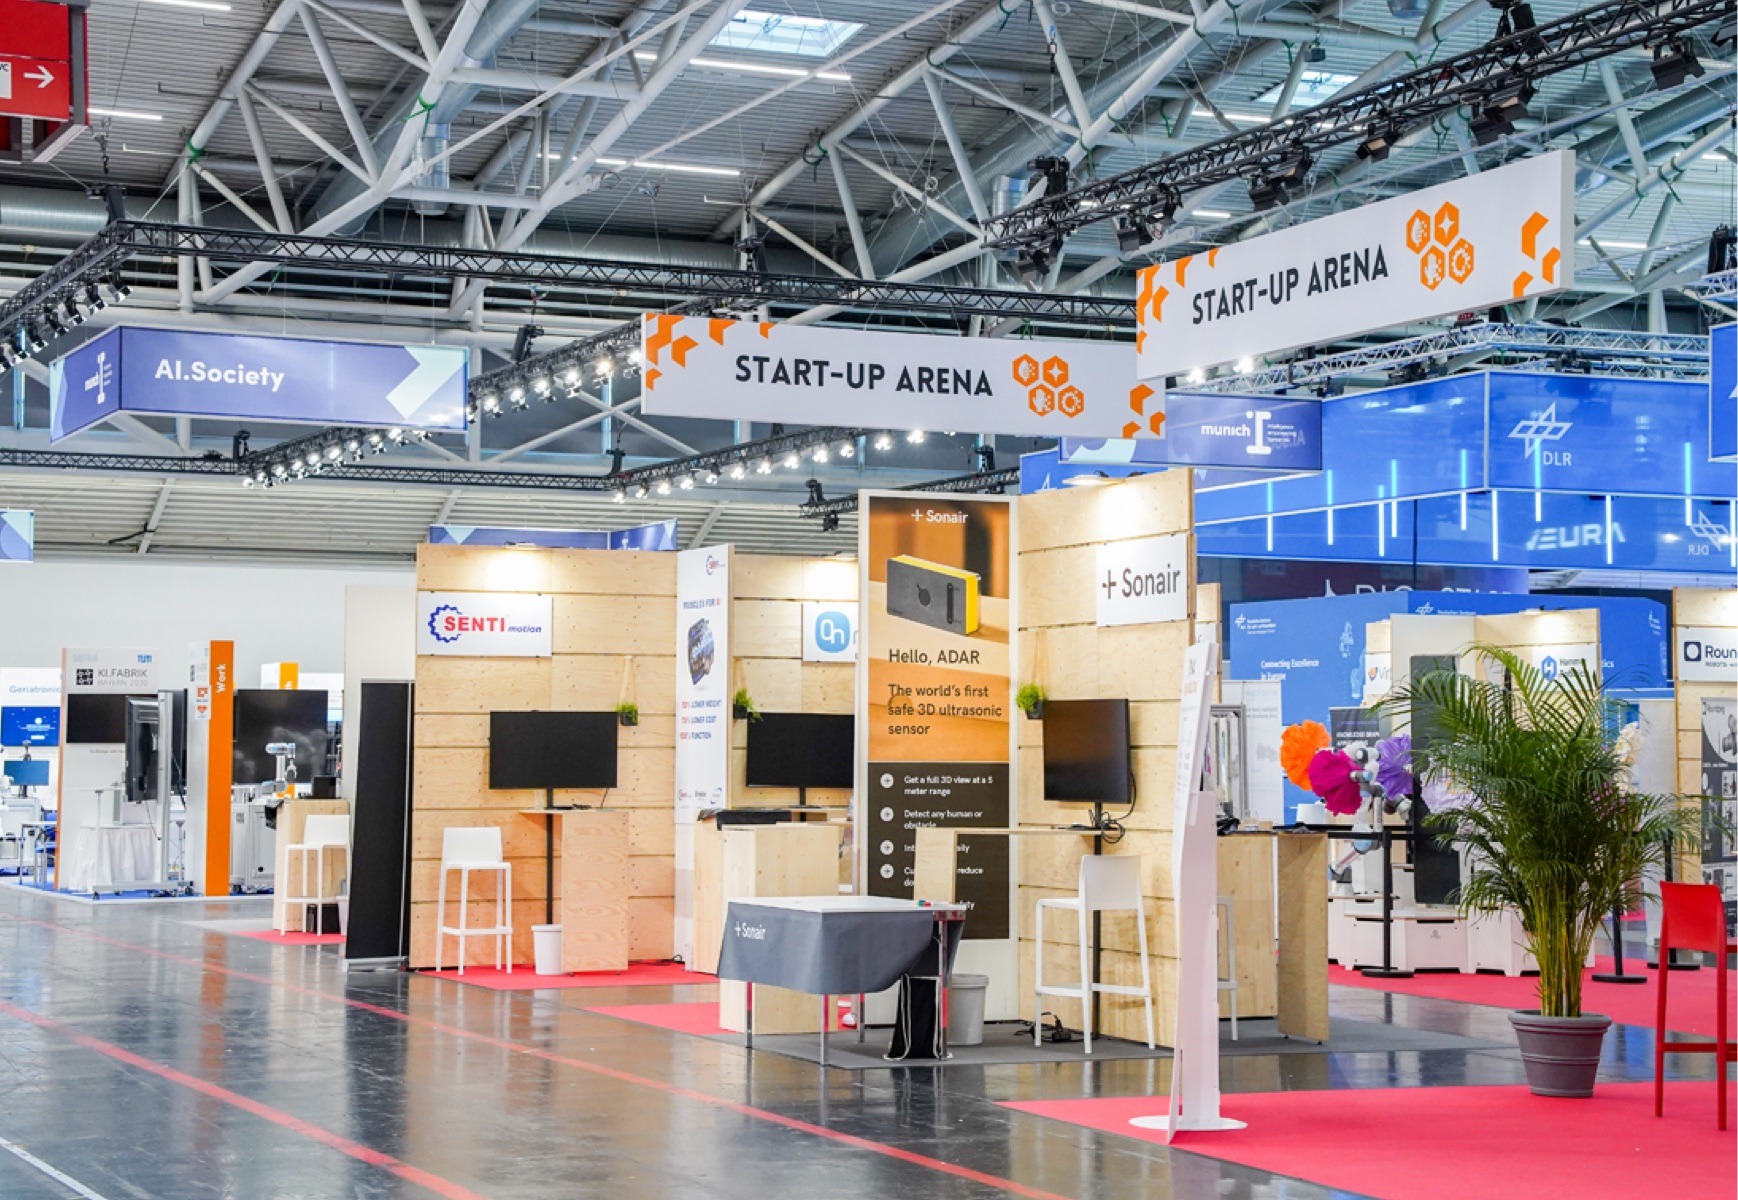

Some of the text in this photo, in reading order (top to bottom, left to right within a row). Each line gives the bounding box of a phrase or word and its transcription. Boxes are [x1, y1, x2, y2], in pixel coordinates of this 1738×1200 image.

[1192, 244, 1390, 325] START-UP ARENA
[155, 359, 285, 392] AI.Society
[735, 355, 993, 397] START-UP ARENA
[1200, 423, 1251, 438] munich
[1543, 450, 1572, 467] DLR
[926, 509, 968, 524] Sonair
[1122, 562, 1181, 598] Sonair
[444, 616, 542, 633] SENTI motion
[889, 648, 980, 666] Hello, ADAR
[1260, 658, 1320, 670] Connecting Excellence
[98, 668, 148, 678] KI.FABRIK
[888, 683, 990, 697] The world's first
[888, 703, 1002, 717] safe 3D ultrasonic
[888, 725, 930, 735] sensor
[904, 775, 919, 784] Get
[926, 775, 940, 784] full
[941, 776, 953, 784] 3D
[954, 776, 971, 784] view
[972, 776, 980, 784] at
[904, 787, 951, 797] meter range
[904, 809, 930, 818] Detect
[931, 811, 945, 819] any
[947, 810, 973, 818] human
[958, 867, 983, 875] reduce
[742, 922, 766, 940] Sonair
